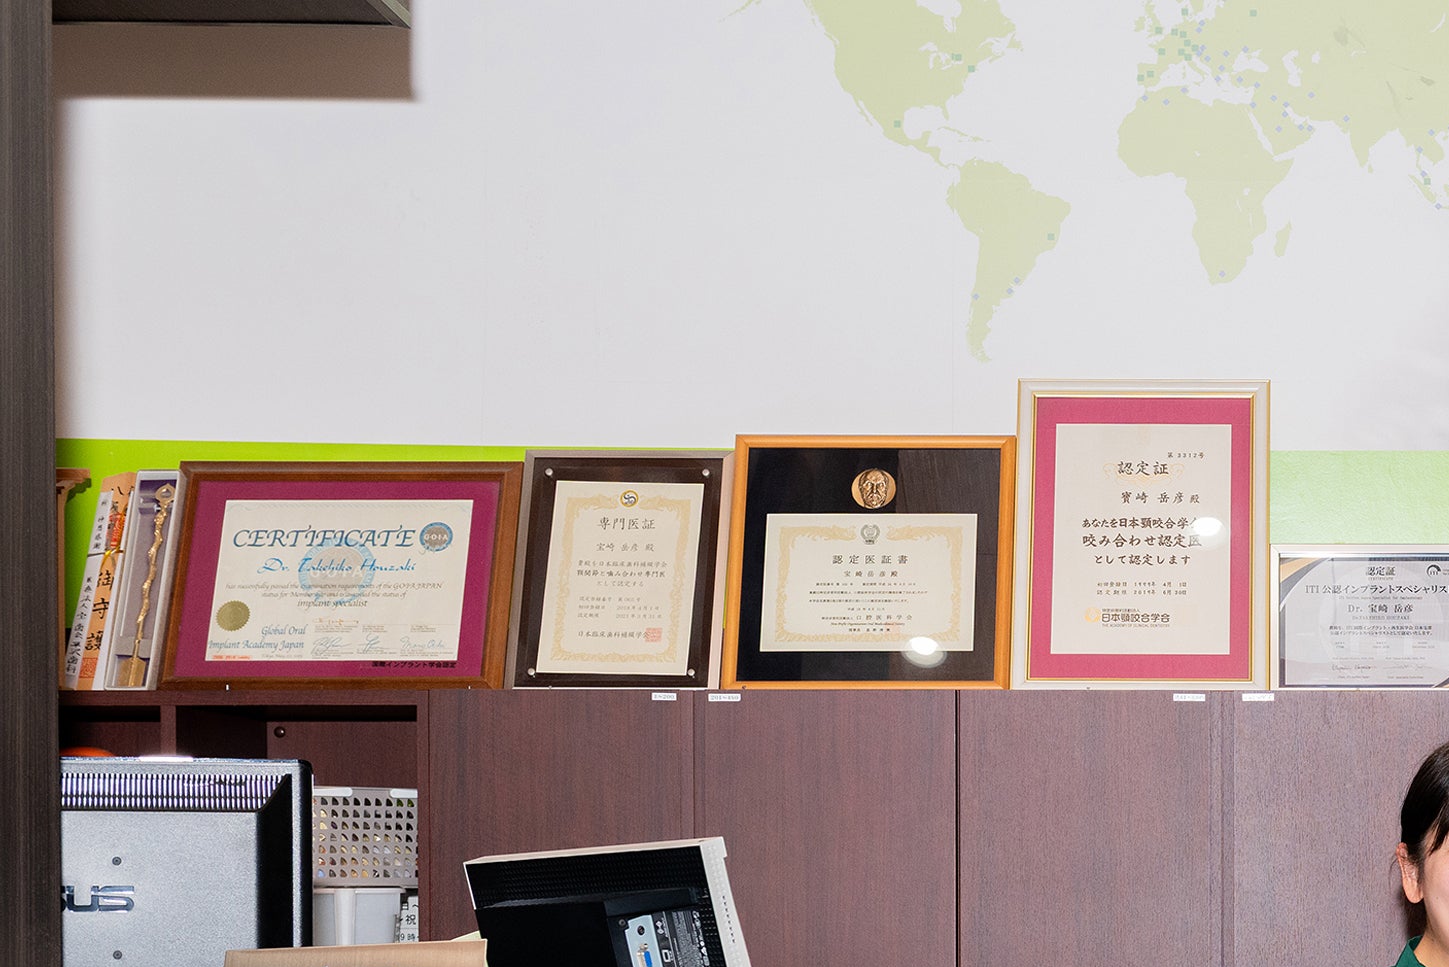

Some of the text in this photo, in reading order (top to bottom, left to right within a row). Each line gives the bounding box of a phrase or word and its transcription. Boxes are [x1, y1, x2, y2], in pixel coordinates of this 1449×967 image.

[1117, 461, 1169, 476] 認定証
[598, 516, 656, 531] 専門医証
[1082, 517, 1198, 529] あなたを日本顎咬合学
[233, 525, 416, 547] CERTIFICATE
[832, 555, 908, 564] 認定医証書
[1094, 554, 1191, 565] として認定します
[257, 558, 289, 573] Dr.
[1365, 566, 1396, 576] 認定証
[1305, 585, 1319, 594] ITI
[1348, 604, 1363, 612] Dr.
[1102, 613, 1170, 623] 日本顎咬合学会
[261, 626, 286, 636] Global
[289, 626, 306, 635] Oral
[244, 640, 279, 652] Academy
[281, 640, 304, 651] Japan
